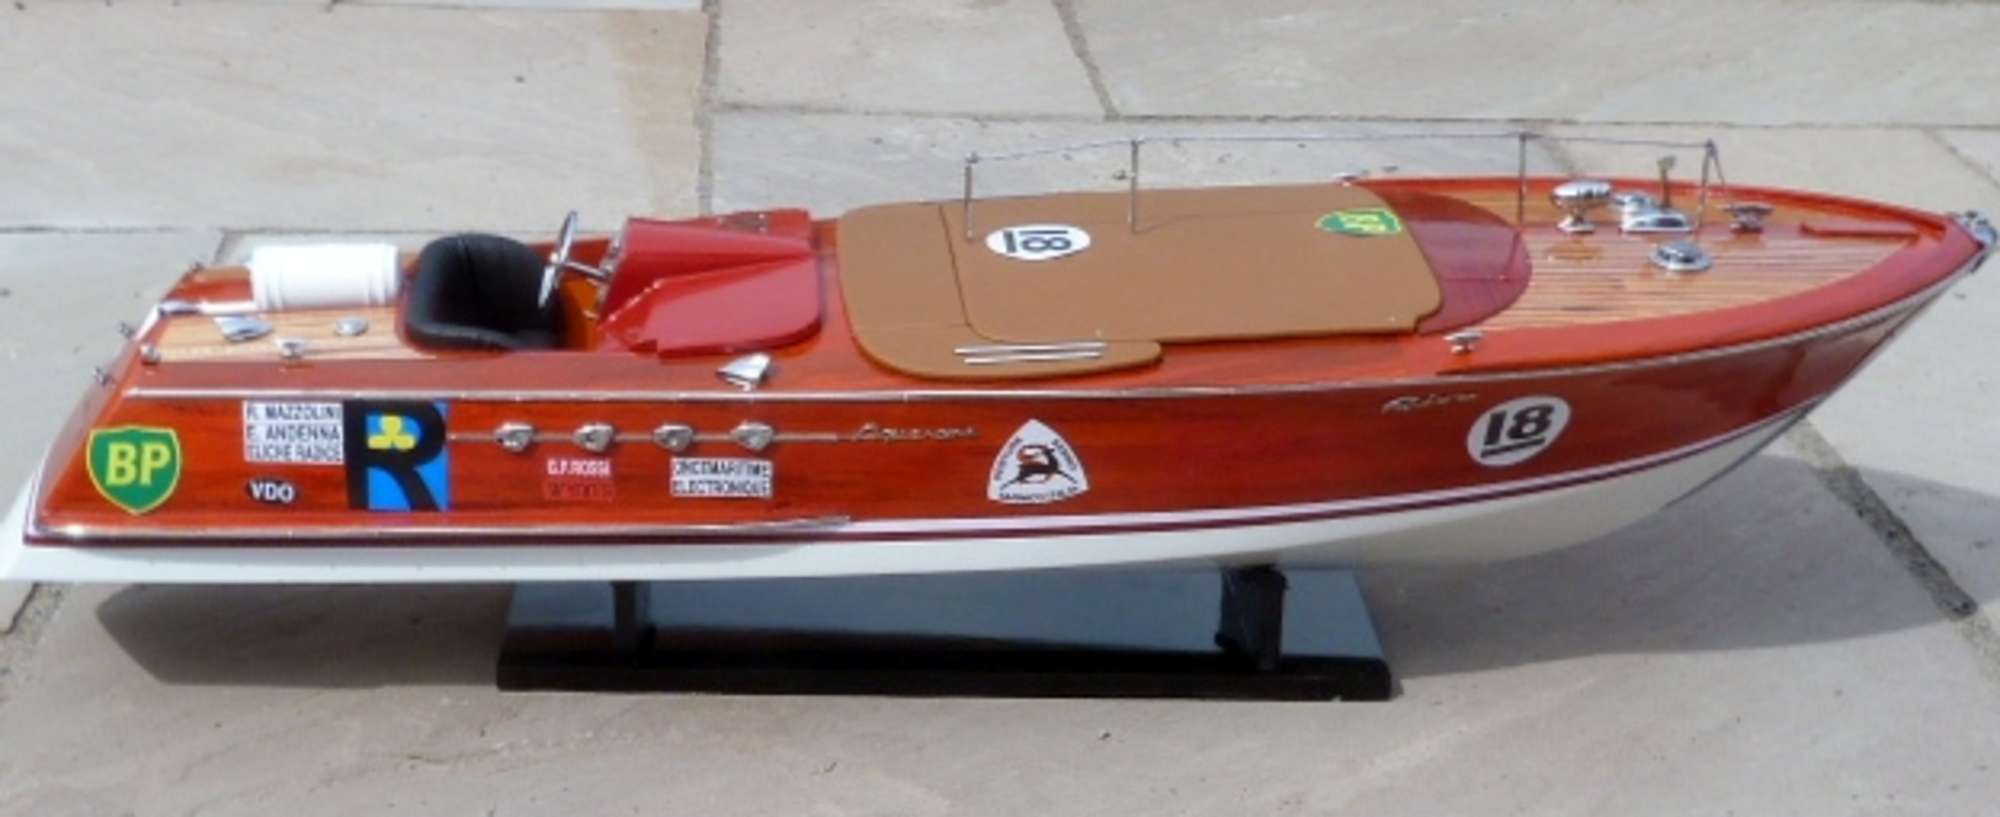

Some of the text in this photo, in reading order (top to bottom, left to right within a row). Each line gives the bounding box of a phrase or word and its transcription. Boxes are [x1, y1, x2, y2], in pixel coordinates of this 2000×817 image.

[1017, 230, 1072, 252] 18
[1483, 404, 1554, 447] 18
[105, 442, 172, 486] BP
[250, 481, 296, 503] VDO
